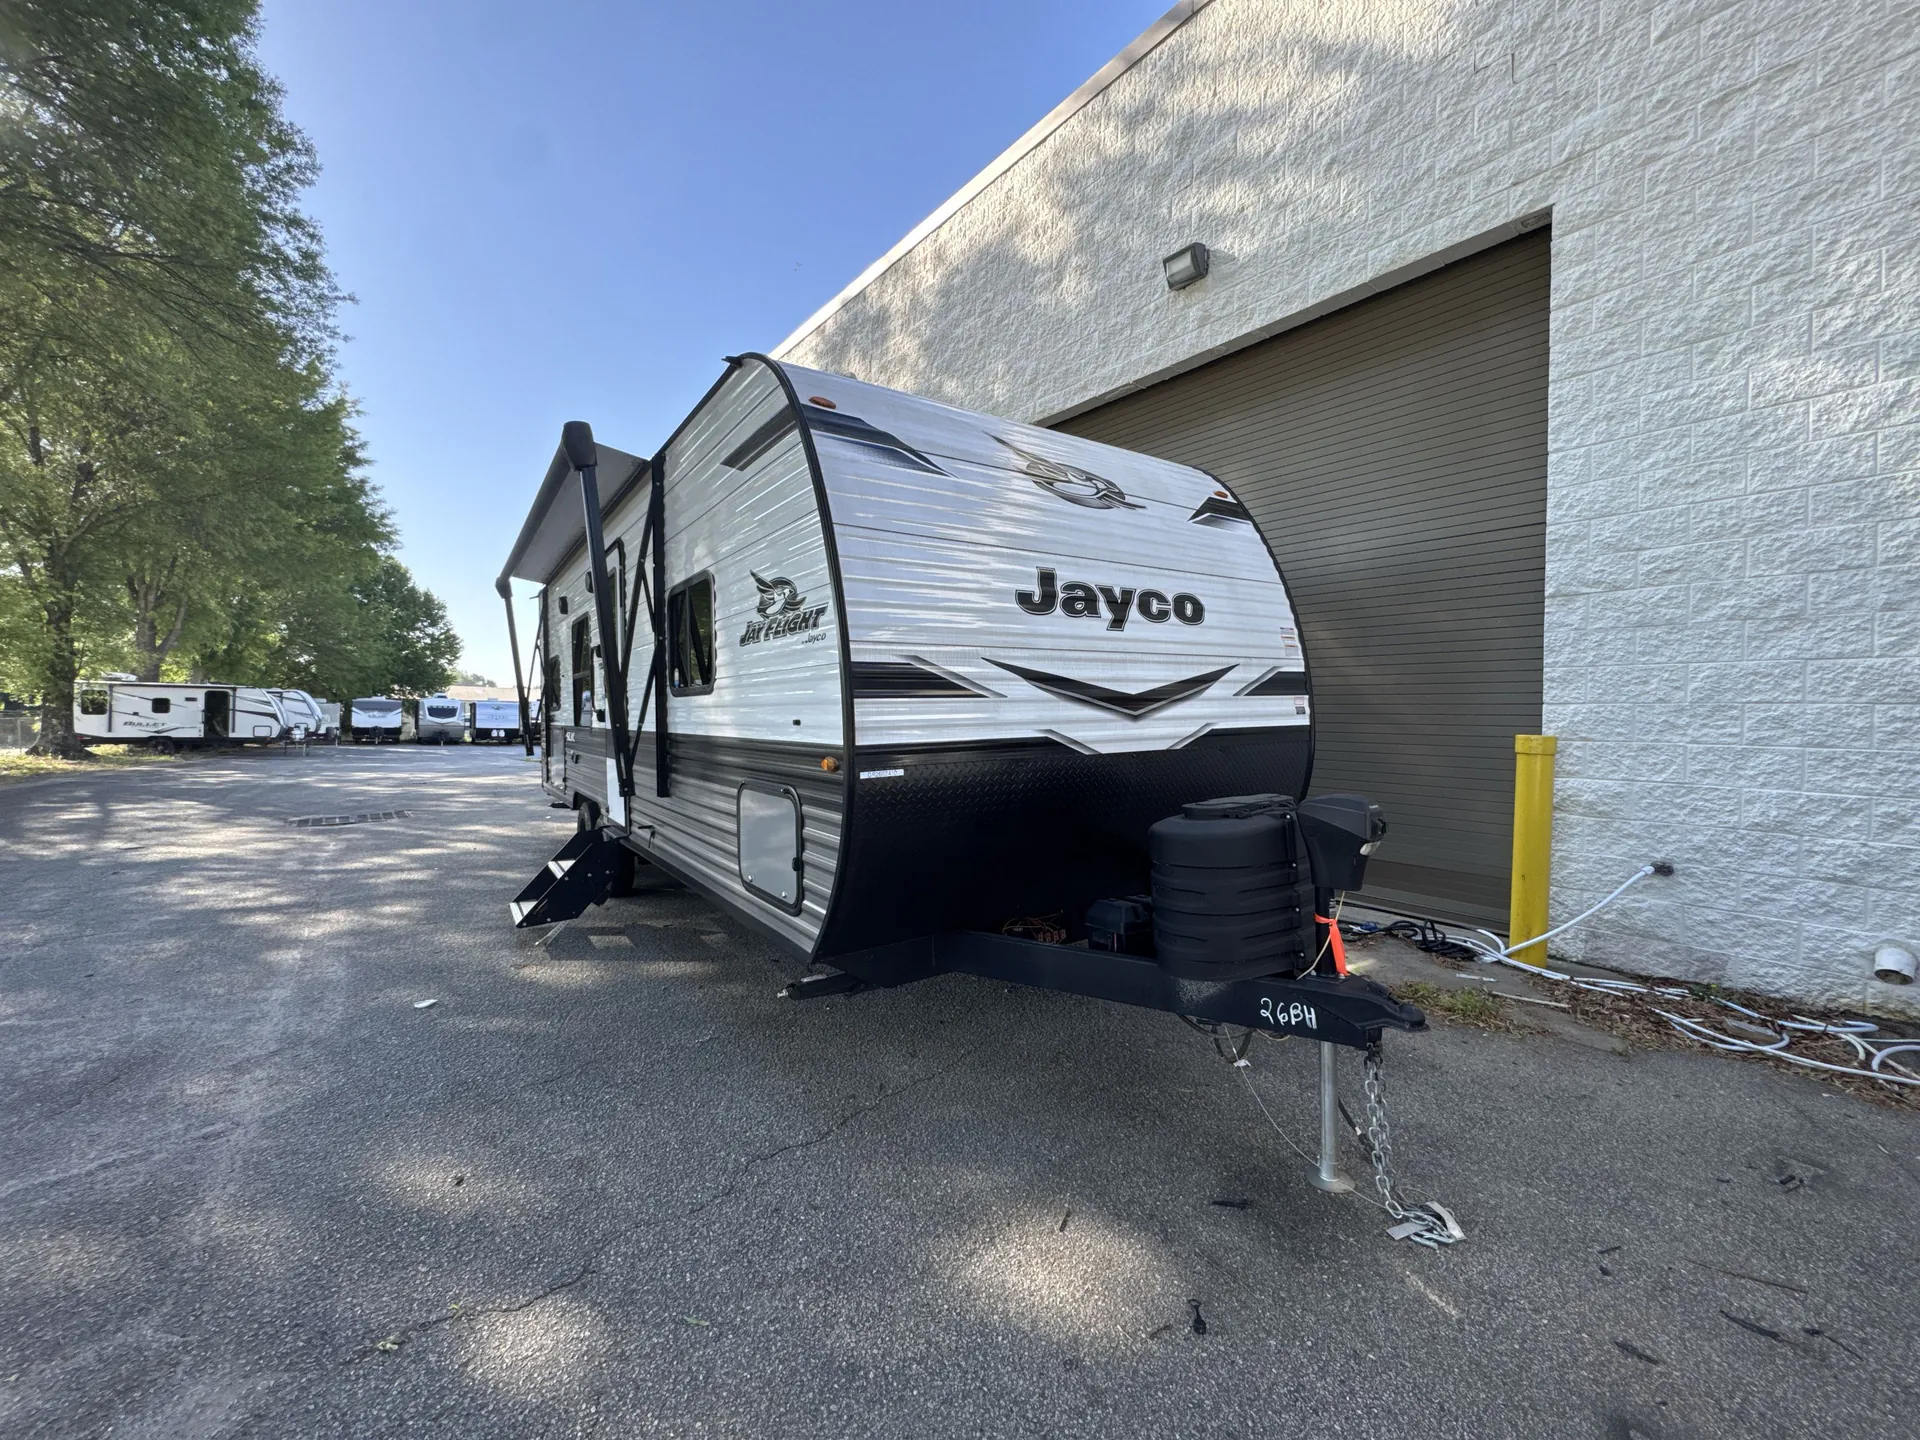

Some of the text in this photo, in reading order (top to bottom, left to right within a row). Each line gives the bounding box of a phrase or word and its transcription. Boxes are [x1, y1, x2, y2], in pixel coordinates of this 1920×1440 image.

[1015, 566, 1205, 631] Jayco
[740, 602, 829, 647] JAY FLIGHT
[1260, 997, 1317, 1030] 26BH
